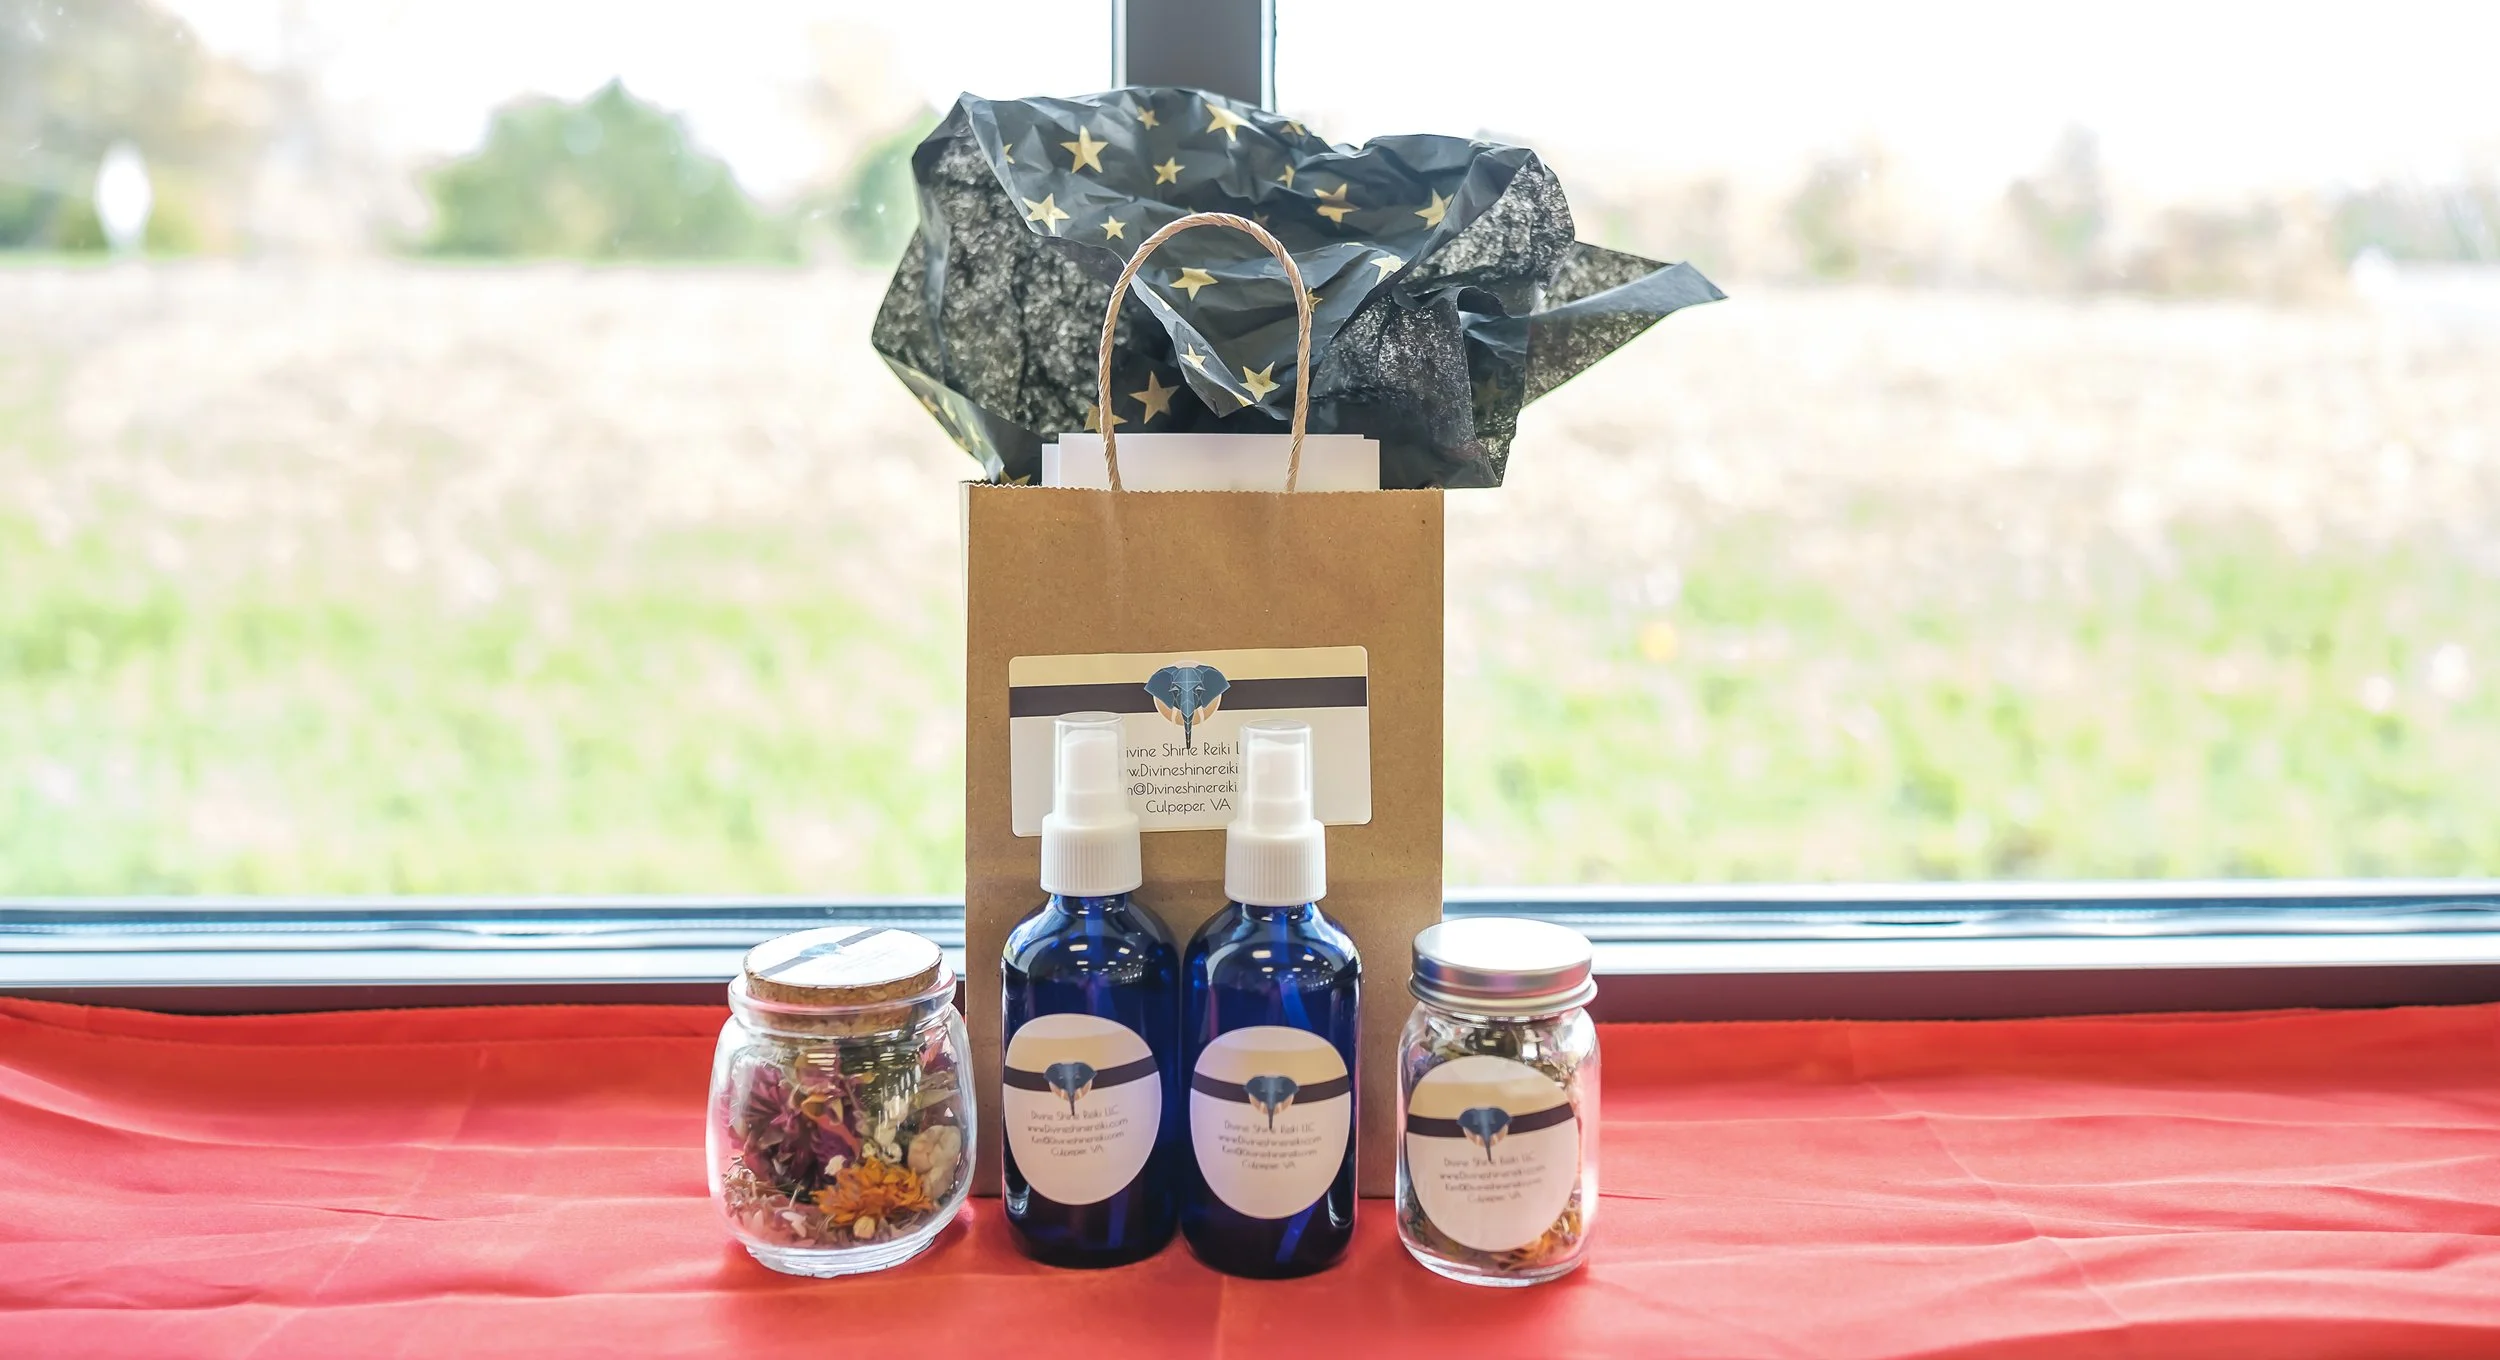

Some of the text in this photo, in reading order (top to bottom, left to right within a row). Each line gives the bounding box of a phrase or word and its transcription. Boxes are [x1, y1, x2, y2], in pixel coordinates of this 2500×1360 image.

[1126, 746, 1156, 758] ivine
[1162, 743, 1198, 757] Shine
[1203, 741, 1230, 755] Reiki
[1126, 760, 1238, 777] w.Divineshinereiki
[1210, 798, 1232, 811] VA
